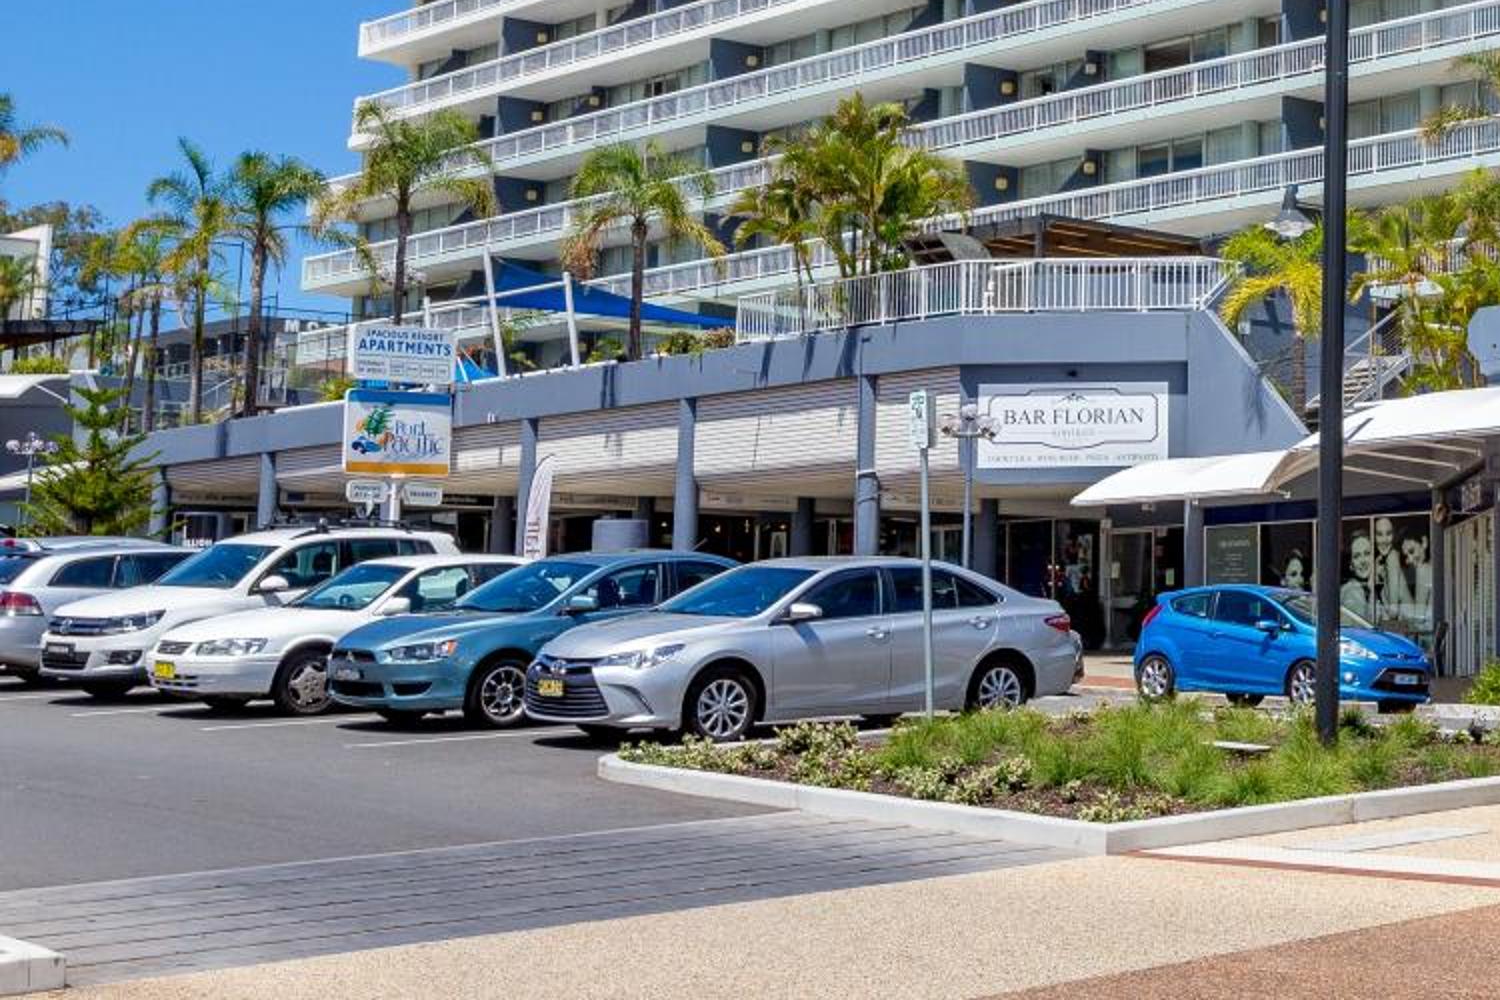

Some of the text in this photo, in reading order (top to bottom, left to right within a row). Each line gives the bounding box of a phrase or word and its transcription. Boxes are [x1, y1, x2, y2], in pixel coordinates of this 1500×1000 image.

[358, 338, 452, 356] APARTMENTS
[1003, 407, 1146, 425] BAR FLORIAN
